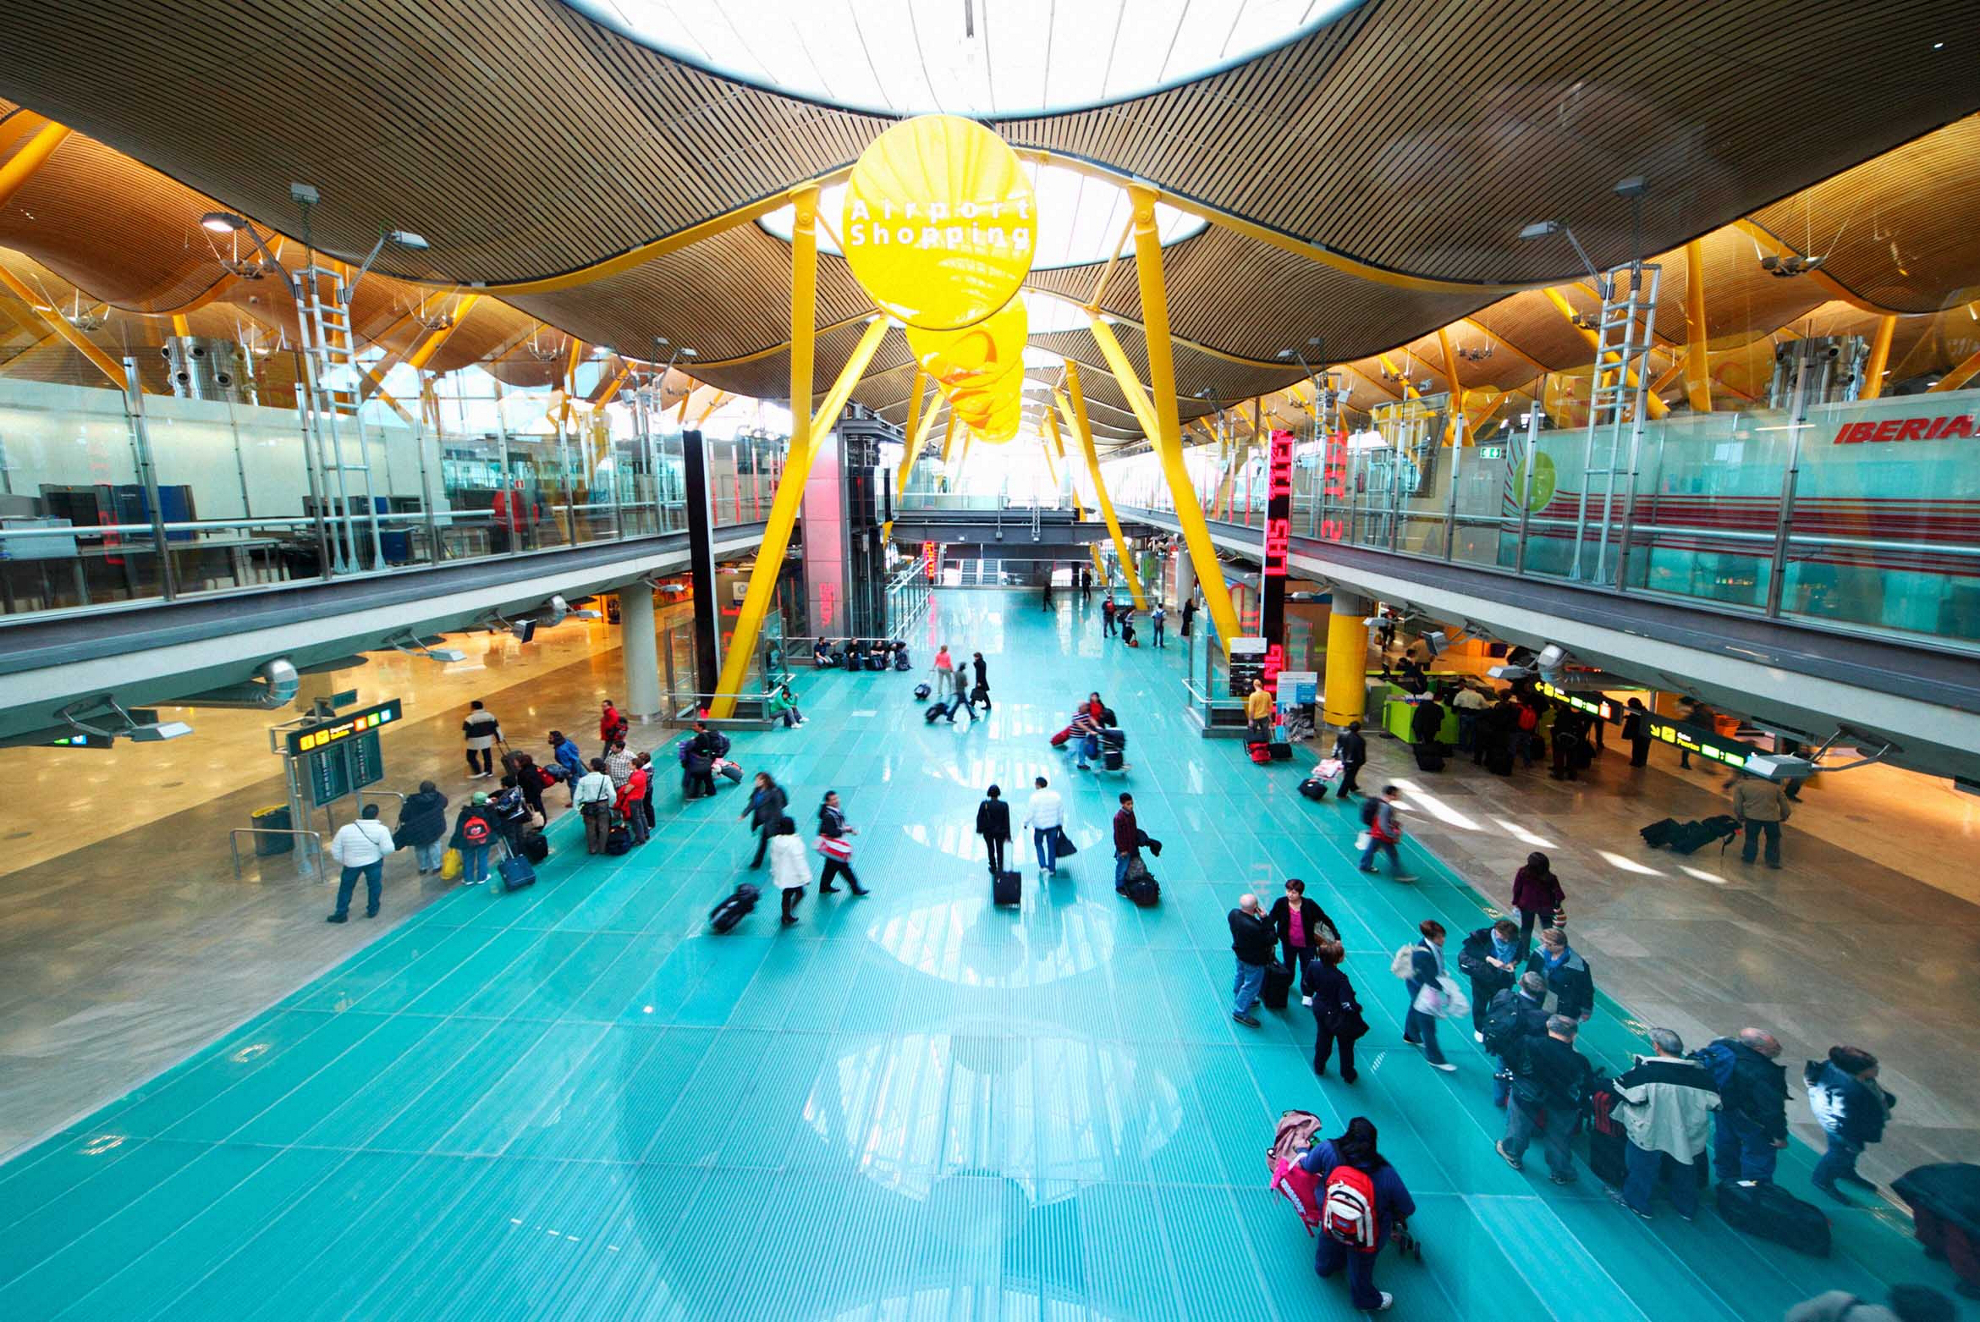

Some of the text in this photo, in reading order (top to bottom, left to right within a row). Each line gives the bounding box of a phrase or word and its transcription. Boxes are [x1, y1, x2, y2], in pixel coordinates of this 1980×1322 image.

[850, 198, 1030, 223] Airport
[850, 222, 1030, 250] Shopping
[1834, 415, 1974, 444] IBERIA
[1265, 519, 1290, 575] LAS
